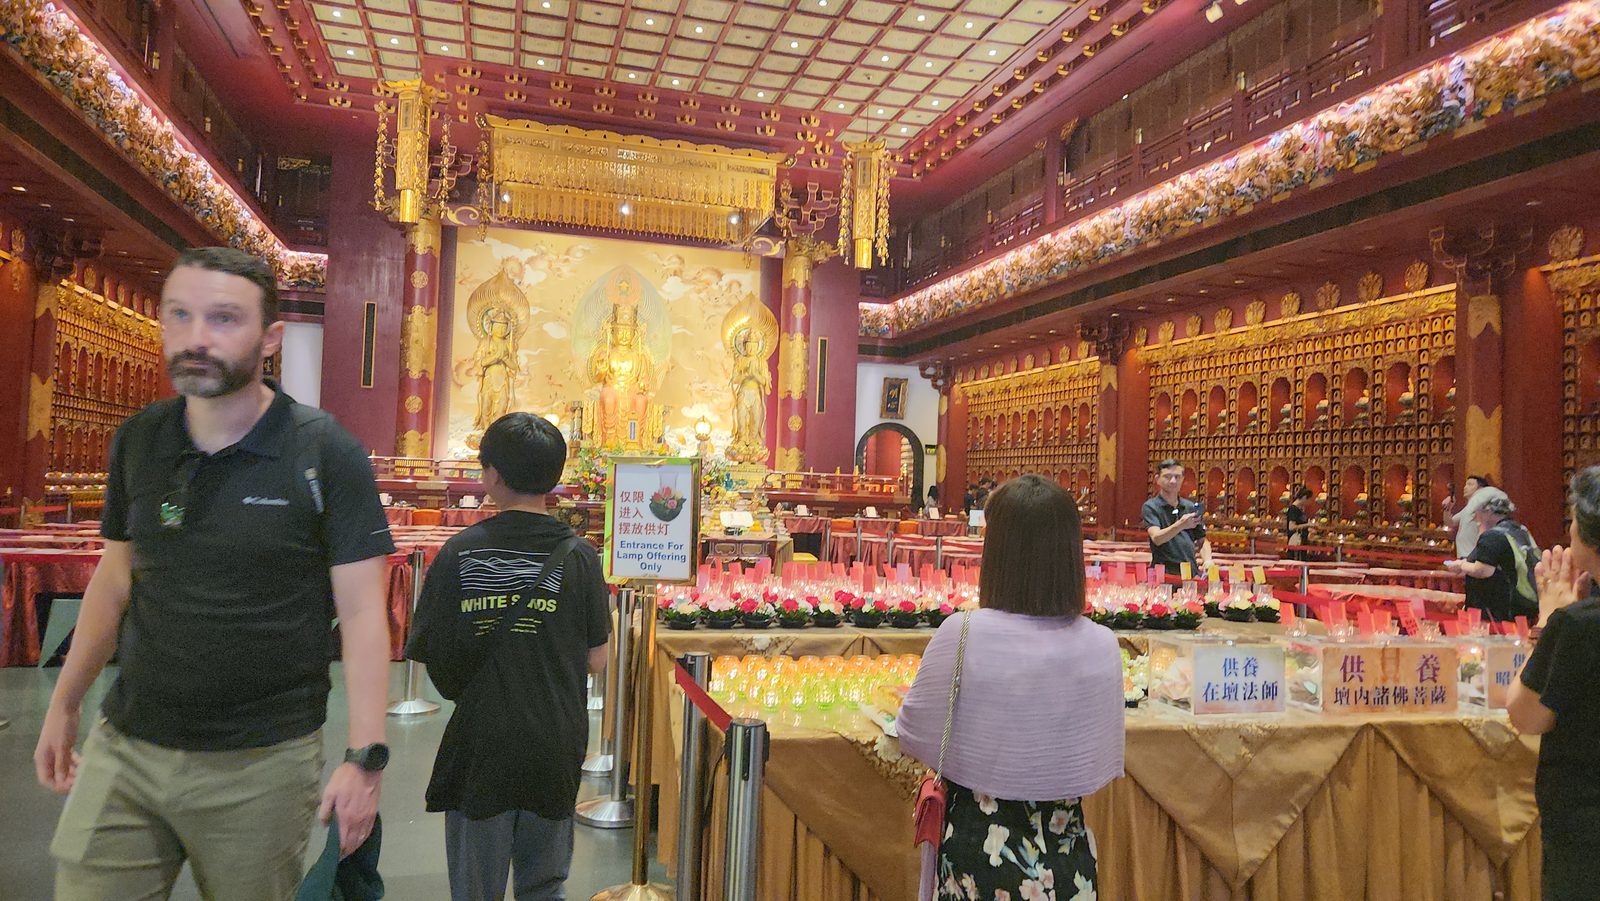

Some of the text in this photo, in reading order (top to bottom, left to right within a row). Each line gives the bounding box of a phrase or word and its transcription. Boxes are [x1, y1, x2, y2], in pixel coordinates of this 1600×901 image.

[620, 490, 645, 503] 仅限
[619, 506, 643, 519] 进入
[619, 522, 670, 536] 摆放供灯
[620, 540, 684, 551] Entrance For
[616, 550, 687, 563] Lamp Offering
[640, 562, 662, 573] Only
[460, 594, 557, 613] WHITE SNDS
[1222, 657, 1259, 677] 供養
[1202, 680, 1279, 703] 在壇法師
